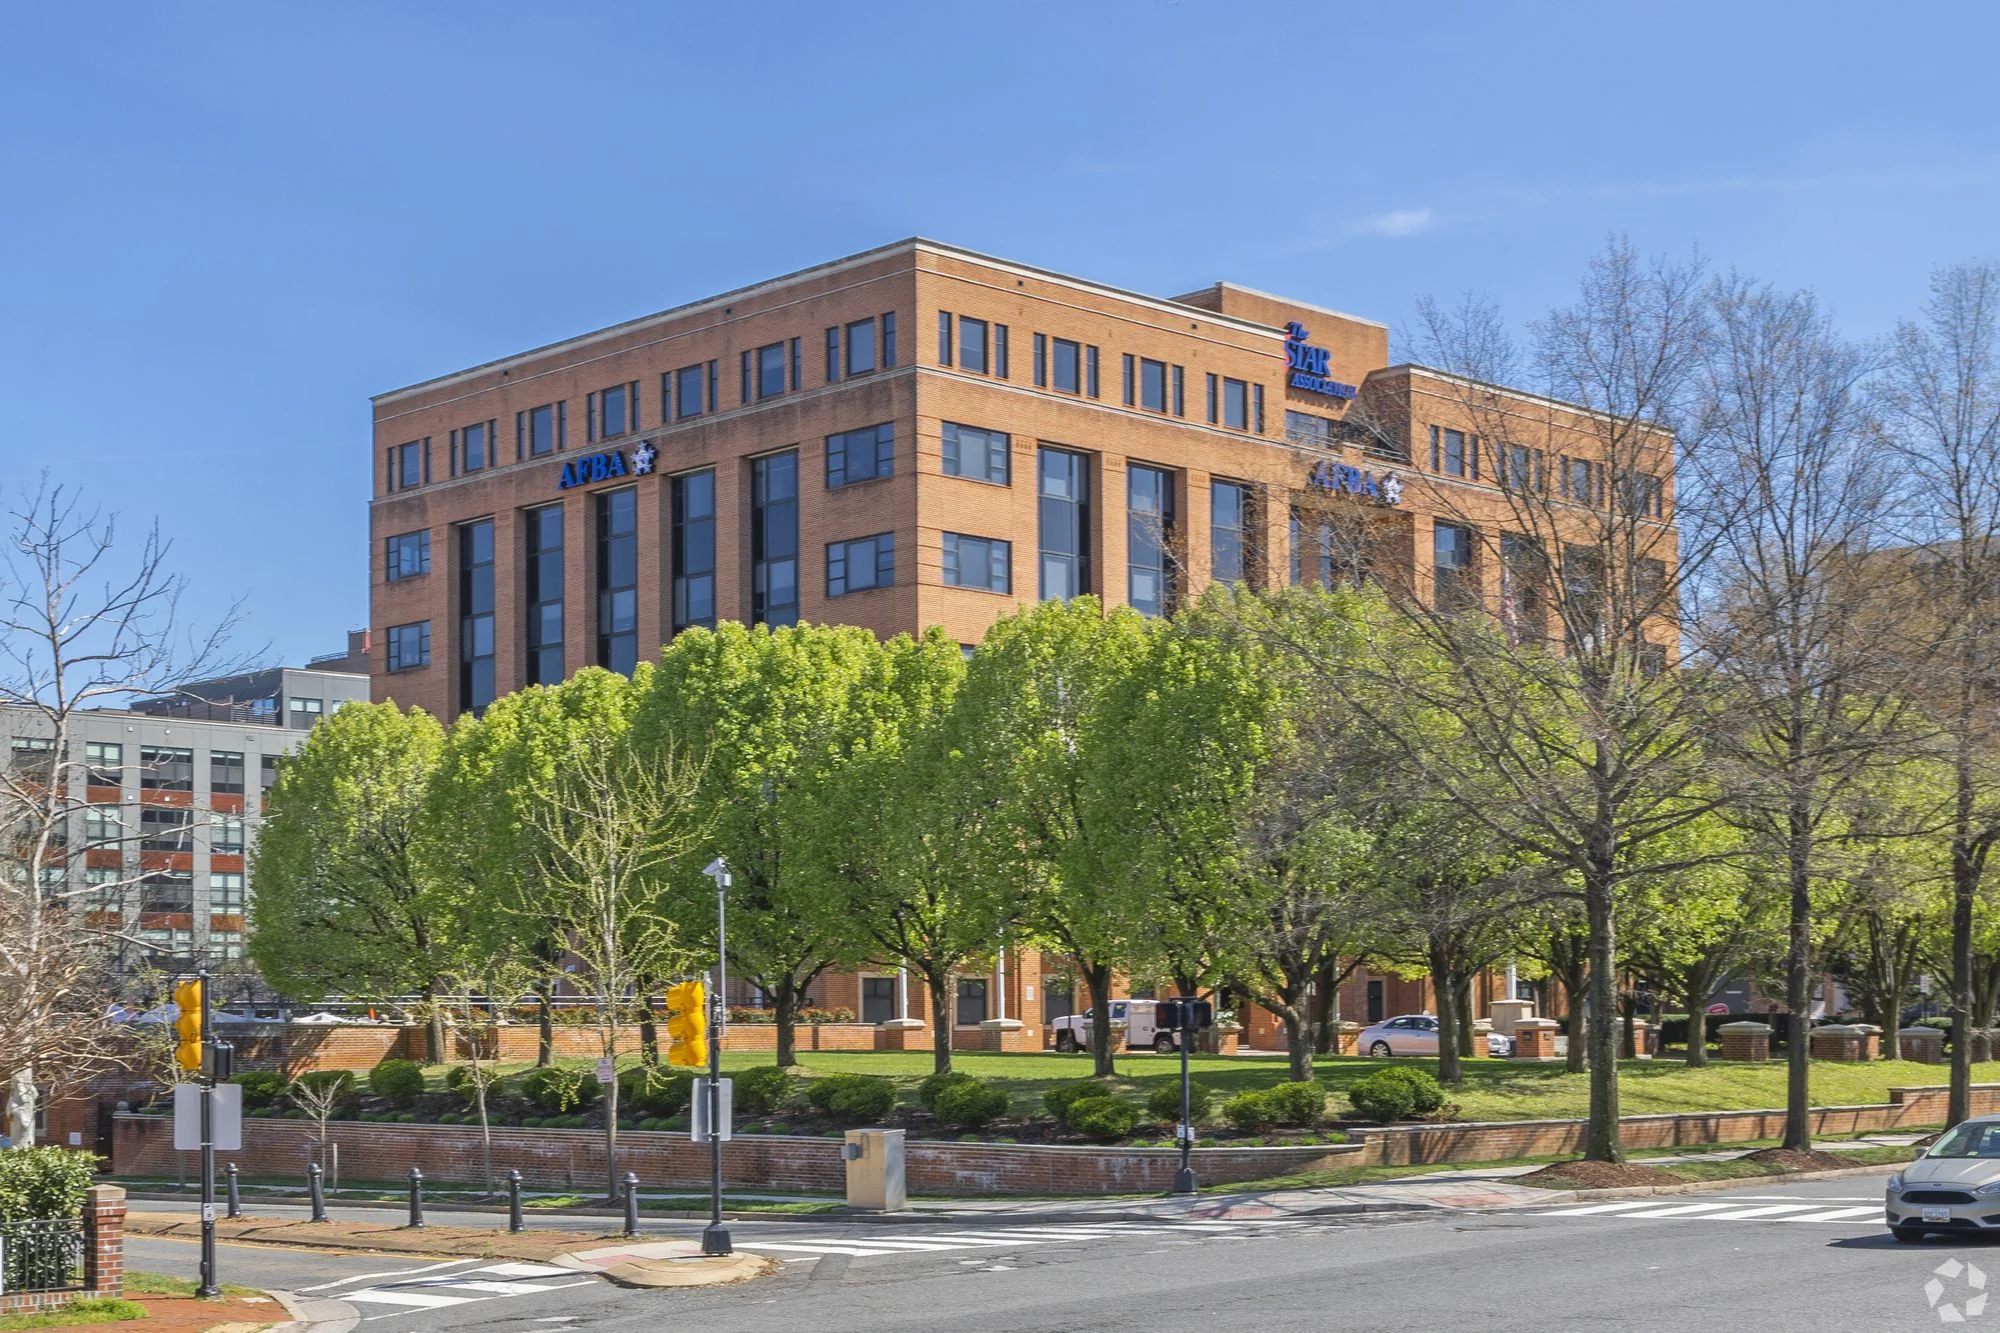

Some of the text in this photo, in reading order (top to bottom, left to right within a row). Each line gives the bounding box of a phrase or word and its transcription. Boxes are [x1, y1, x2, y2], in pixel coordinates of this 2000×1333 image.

[1284, 340, 1331, 377] STAR
[557, 451, 626, 490] AFBA
[1312, 461, 1378, 497] AFBA
